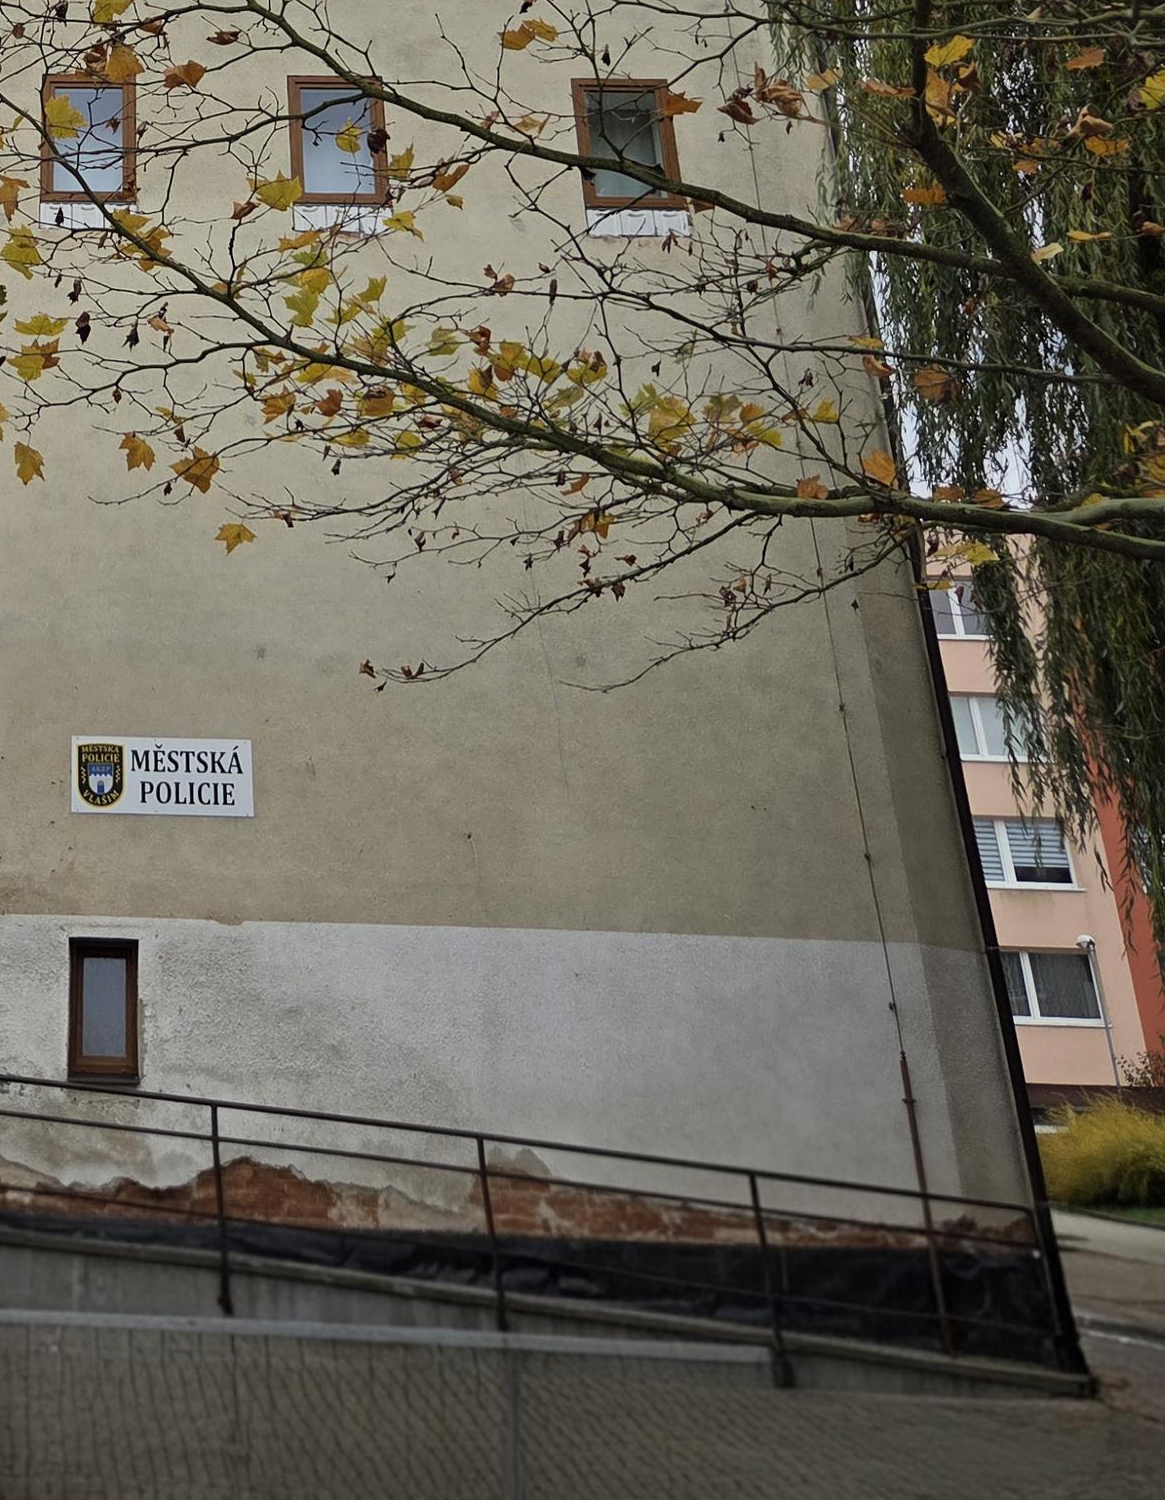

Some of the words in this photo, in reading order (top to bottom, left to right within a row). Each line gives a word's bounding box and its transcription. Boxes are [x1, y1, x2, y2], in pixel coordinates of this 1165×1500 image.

[82, 753, 120, 762] POLICIE
[131, 744, 243, 774] MĚSTSKÁ
[140, 781, 235, 806] POLICIE
